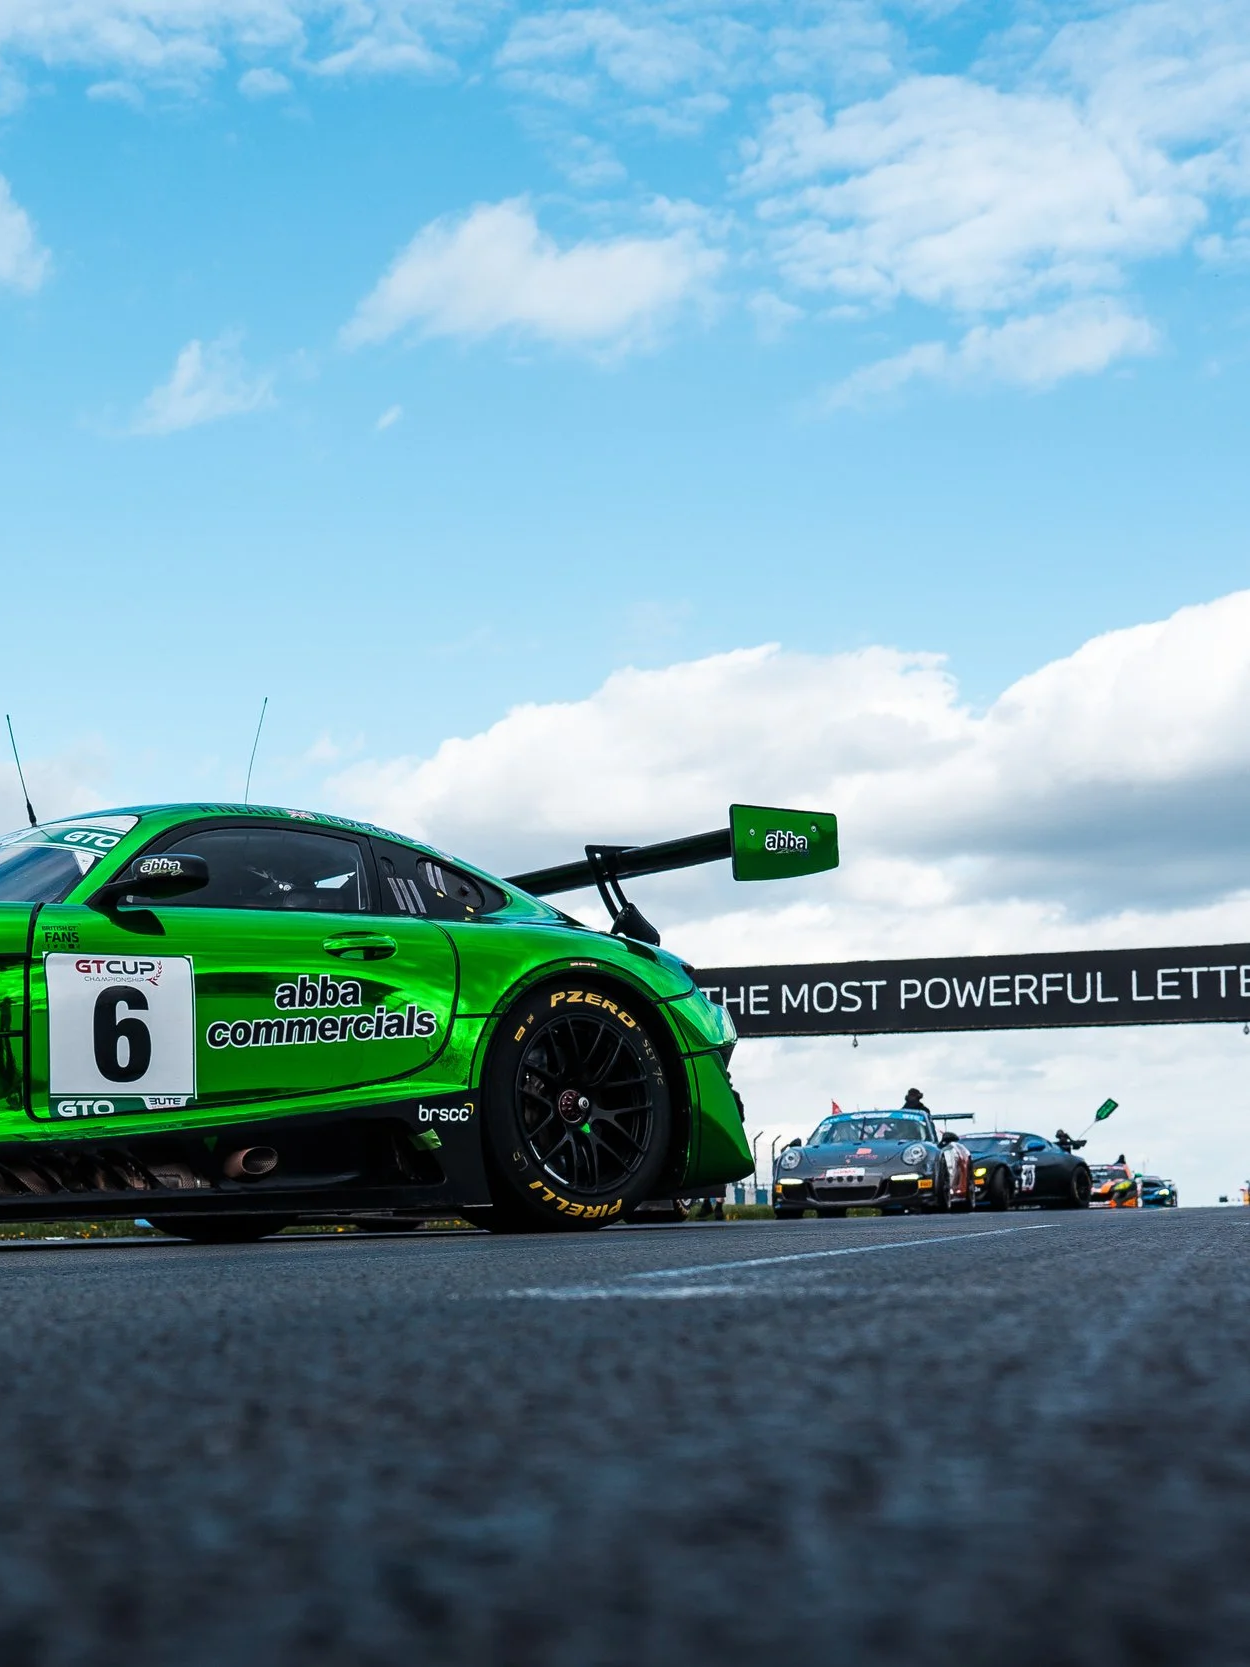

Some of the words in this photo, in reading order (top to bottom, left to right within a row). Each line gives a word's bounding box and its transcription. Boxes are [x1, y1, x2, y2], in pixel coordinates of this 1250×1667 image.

[63, 831, 121, 848] GTO
[765, 830, 808, 851] abba
[140, 858, 181, 873] abba
[45, 932, 80, 943] FANS
[275, 974, 362, 1010] abba
[781, 980, 888, 1015] MOST
[900, 971, 1120, 1010] POWERFUL
[93, 985, 152, 1083] 6
[207, 1004, 437, 1049] commercials
[57, 1100, 115, 1118] GTO
[418, 1104, 471, 1122] brscc
[528, 1180, 623, 1219] PIRELLI
